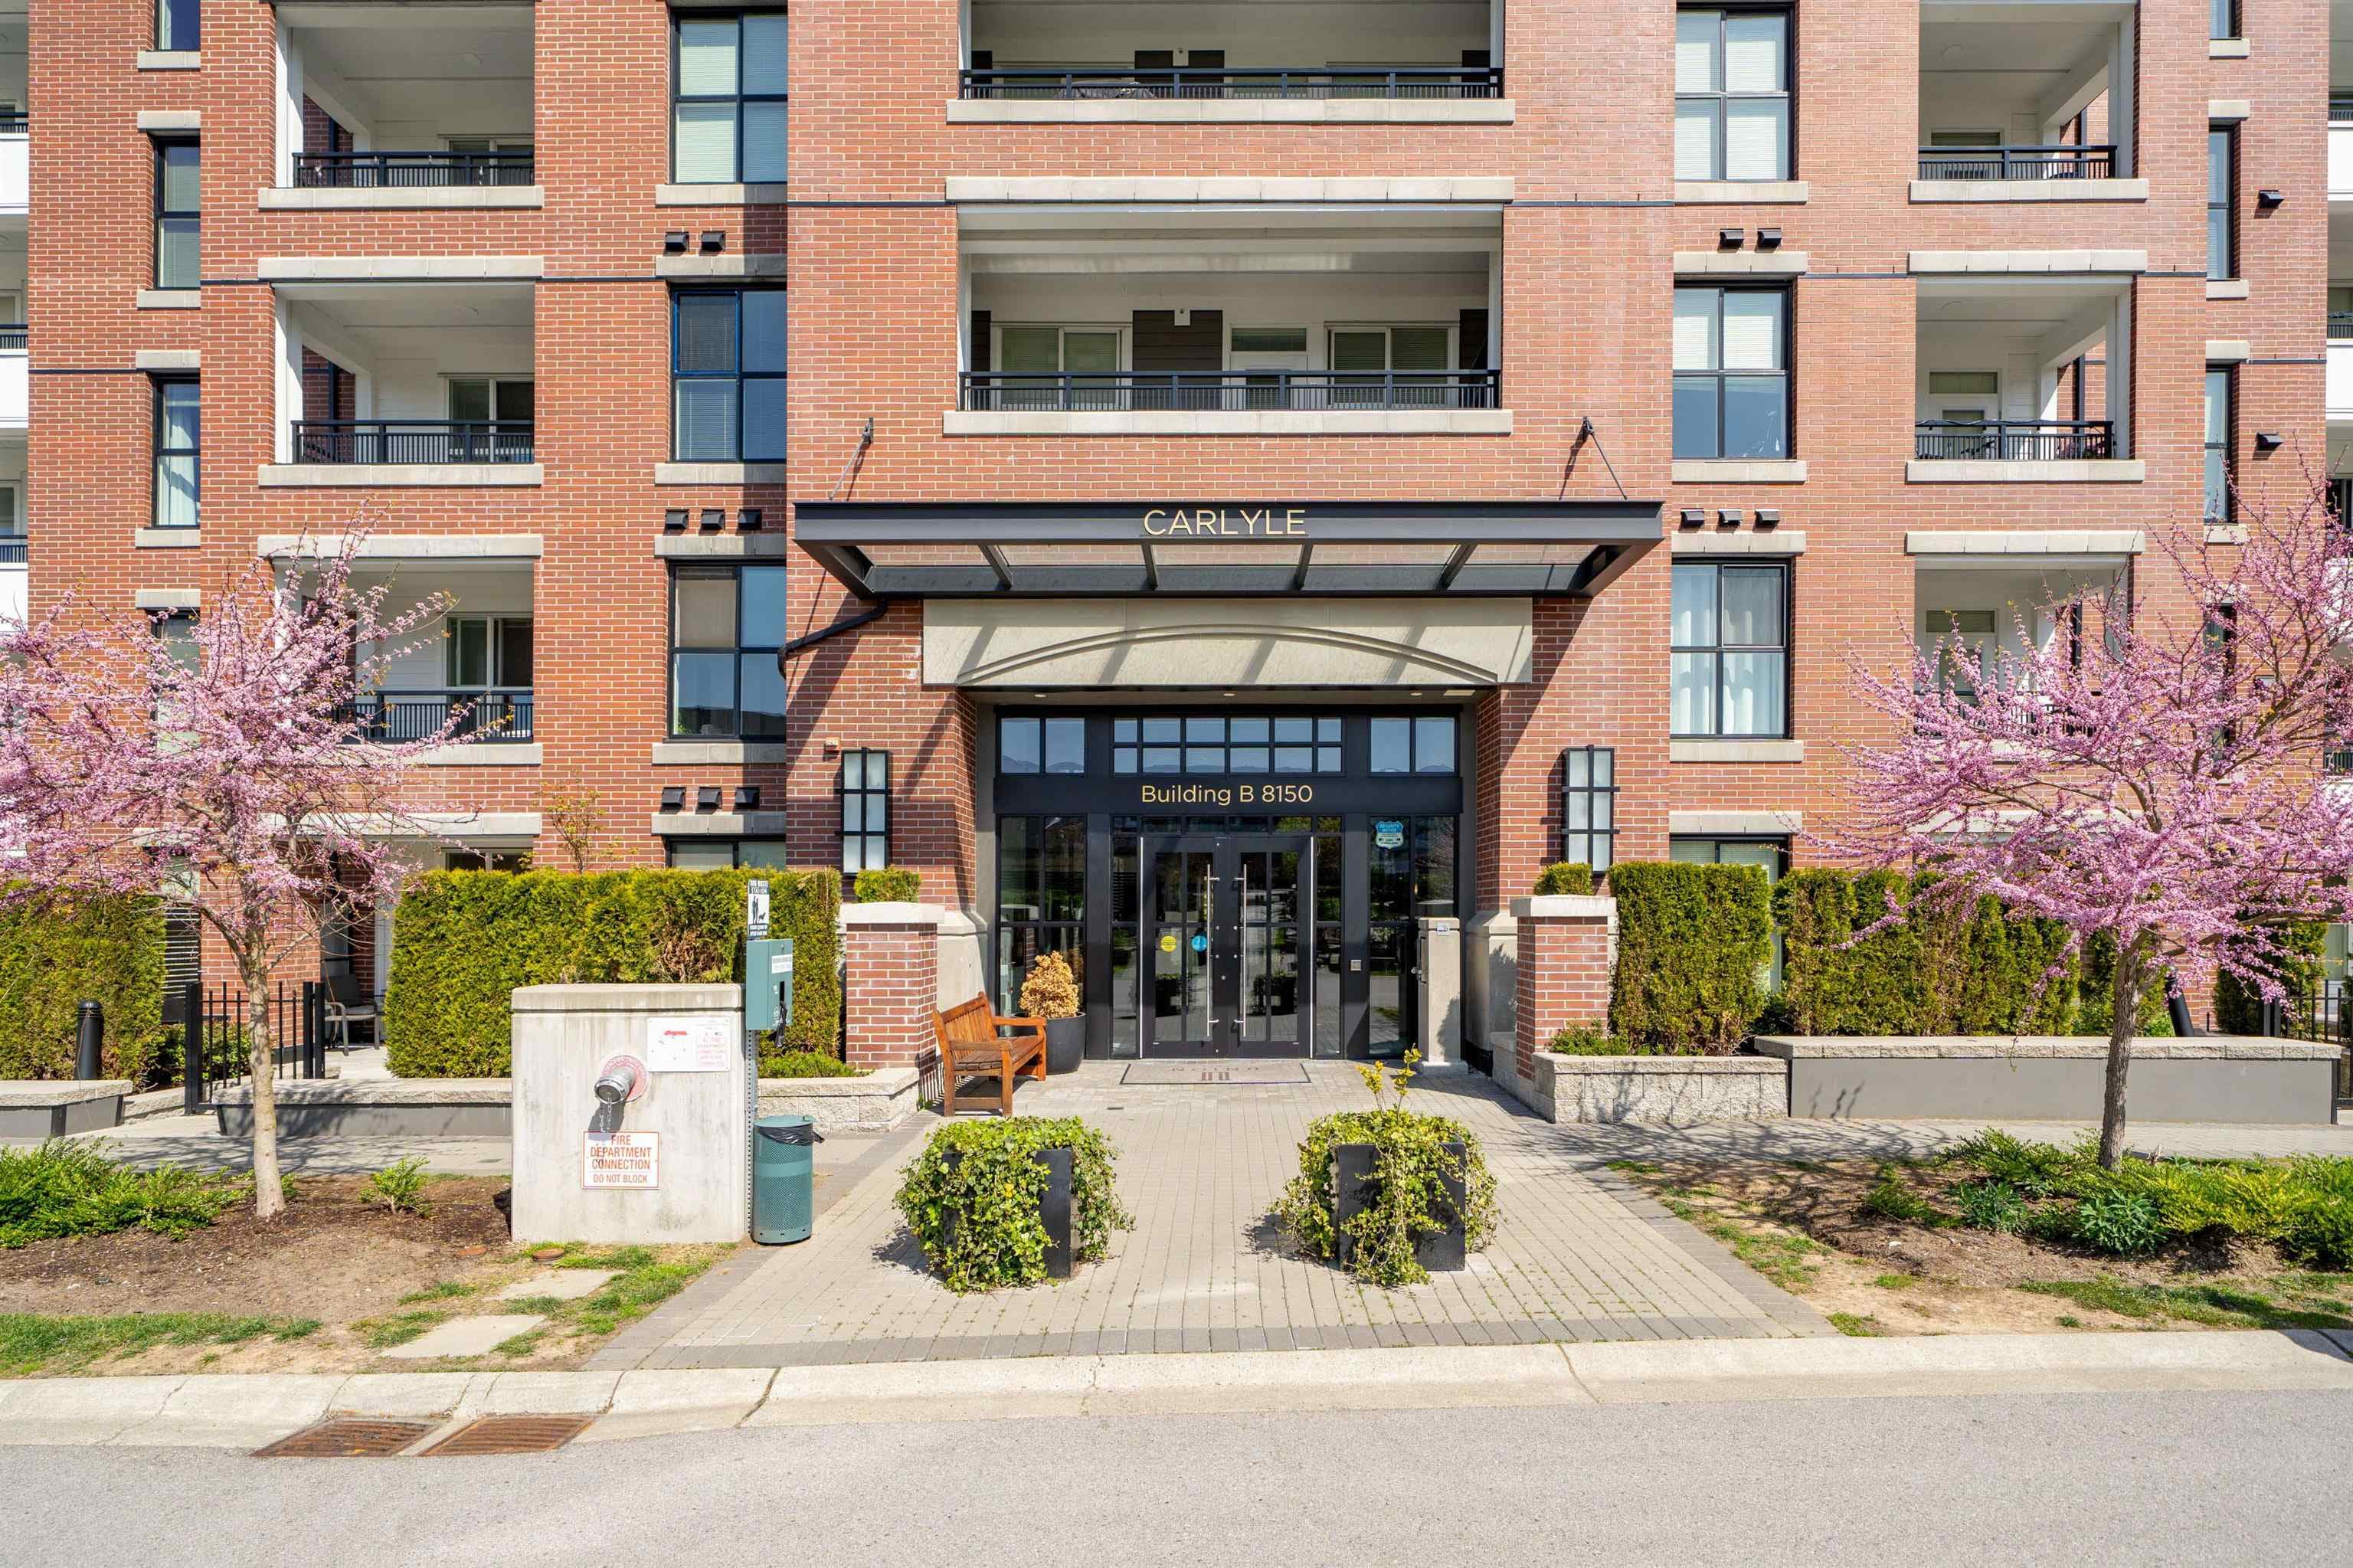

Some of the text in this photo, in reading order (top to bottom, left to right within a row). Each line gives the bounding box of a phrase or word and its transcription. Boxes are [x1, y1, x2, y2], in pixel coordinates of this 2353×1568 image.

[1144, 509, 1306, 535] CARLYLE
[1141, 784, 1313, 806] Building B 8150
[611, 1134, 631, 1146] FIRE
[590, 1147, 651, 1157] DEPARTMENT
[591, 1159, 650, 1170] CONNECTION
[593, 1174, 648, 1183] DO NOT BLOCK
